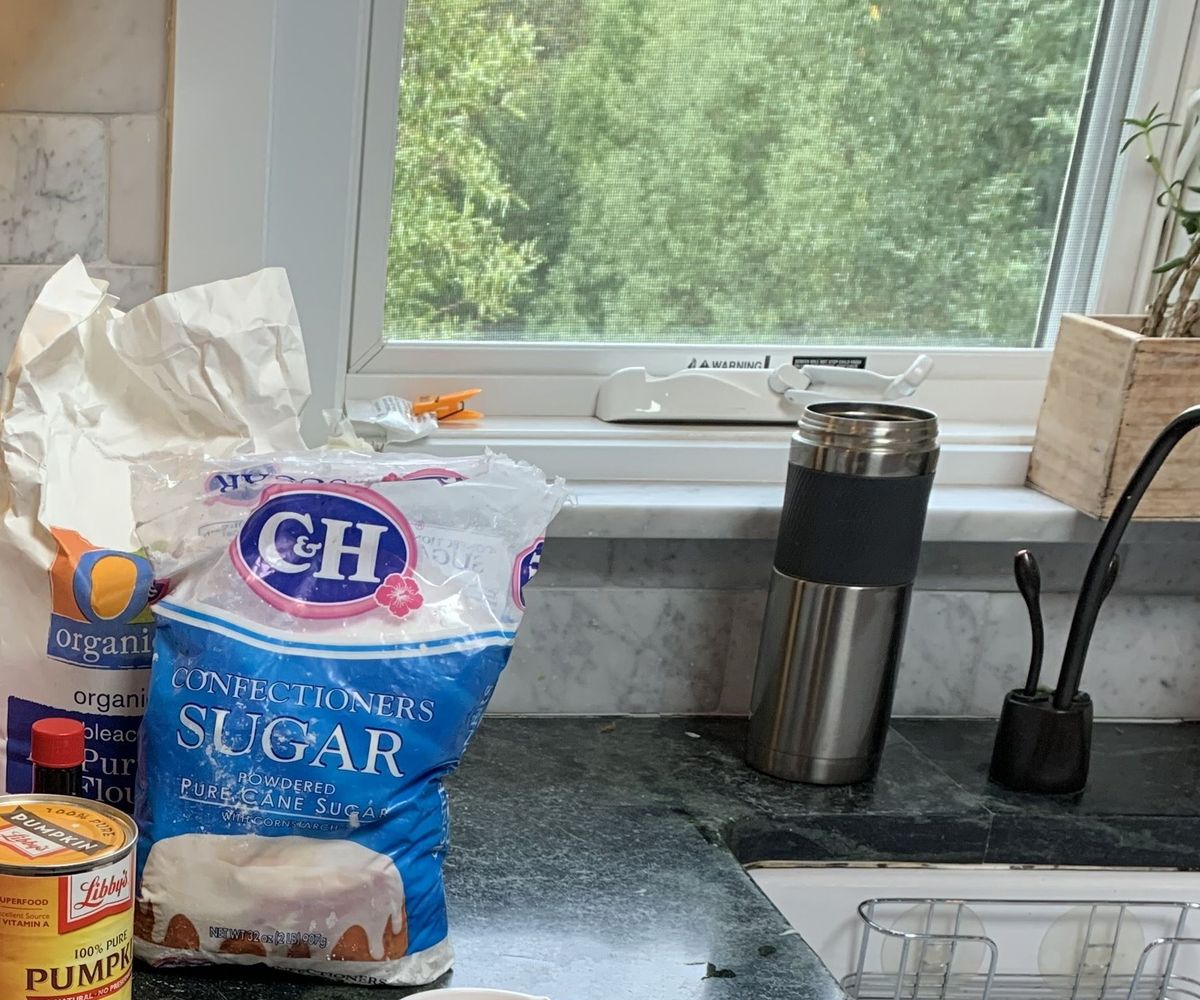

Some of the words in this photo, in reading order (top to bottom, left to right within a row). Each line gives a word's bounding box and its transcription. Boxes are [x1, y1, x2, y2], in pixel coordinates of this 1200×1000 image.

[258, 511, 389, 584] C&H
[56, 627, 152, 663] organi
[74, 688, 146, 713] organi
[171, 667, 436, 722] CONFECTIONERS
[176, 703, 405, 777] SUGAR
[180, 777, 232, 800] PURE
[241, 786, 304, 811] CANE
[315, 796, 390, 819] SUGAR
[238, 771, 336, 796] POWDERED
[10, 812, 99, 851] PUMPKIN
[74, 868, 129, 911] Libby's
[2, 918, 41, 927] VITAMIN
[42, 920, 50, 928] A
[74, 943, 104, 960] 100%
[106, 929, 128, 951] PURE
[98, 986, 109, 997] NO
